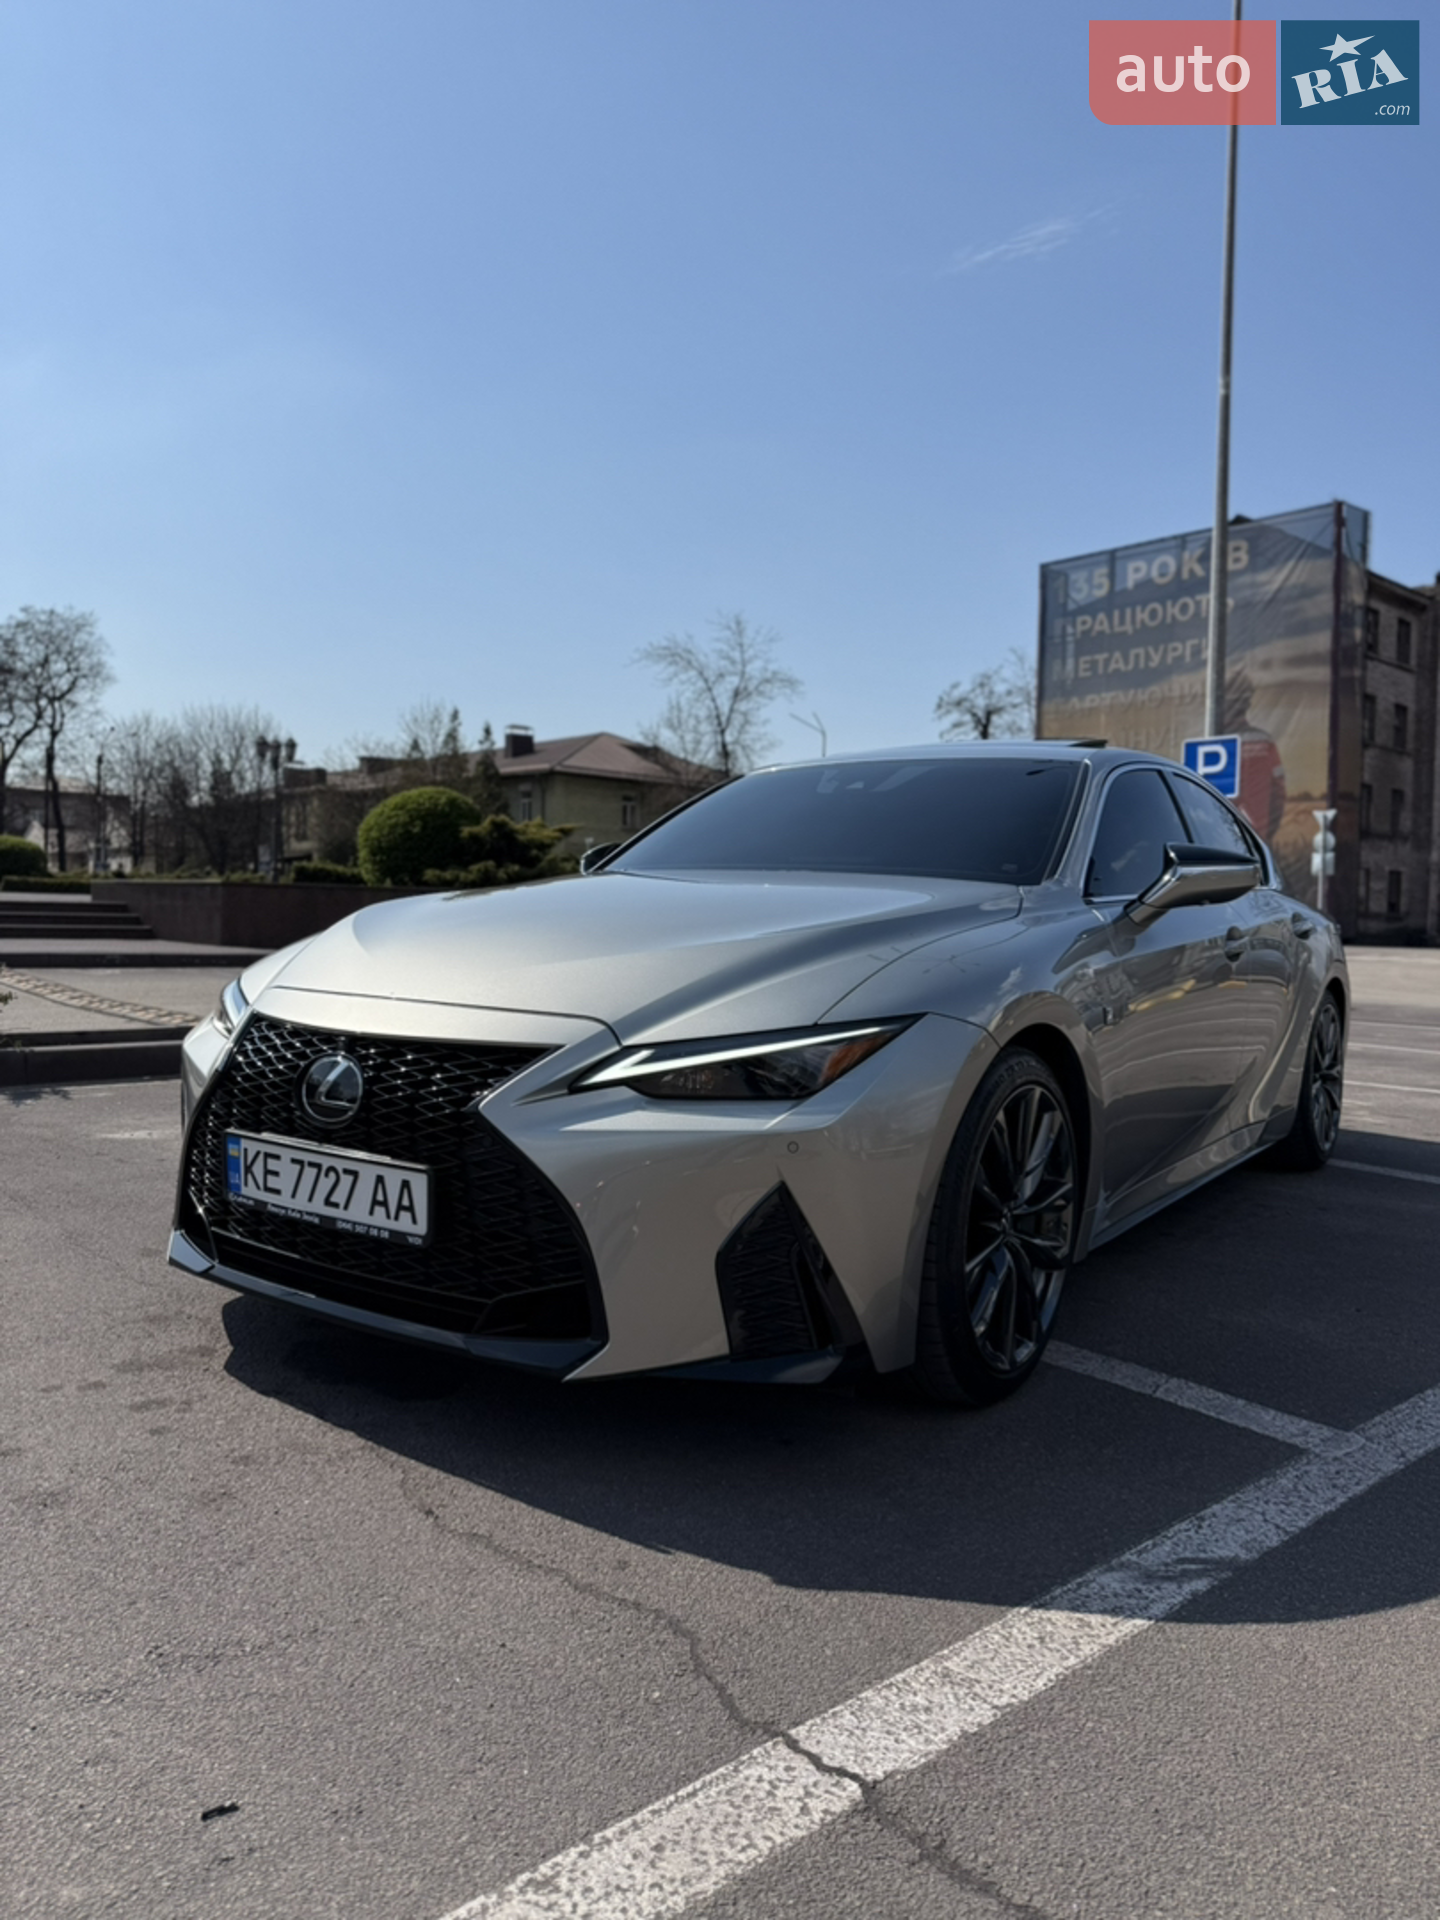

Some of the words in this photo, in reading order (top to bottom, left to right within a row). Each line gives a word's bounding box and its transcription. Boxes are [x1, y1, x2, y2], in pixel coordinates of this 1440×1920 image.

[1127, 540, 1249, 591] РОКВ
[1197, 745, 1228, 775] P
[243, 1147, 282, 1196] KE
[290, 1158, 360, 1211] 7727
[369, 1174, 418, 1226] AA
